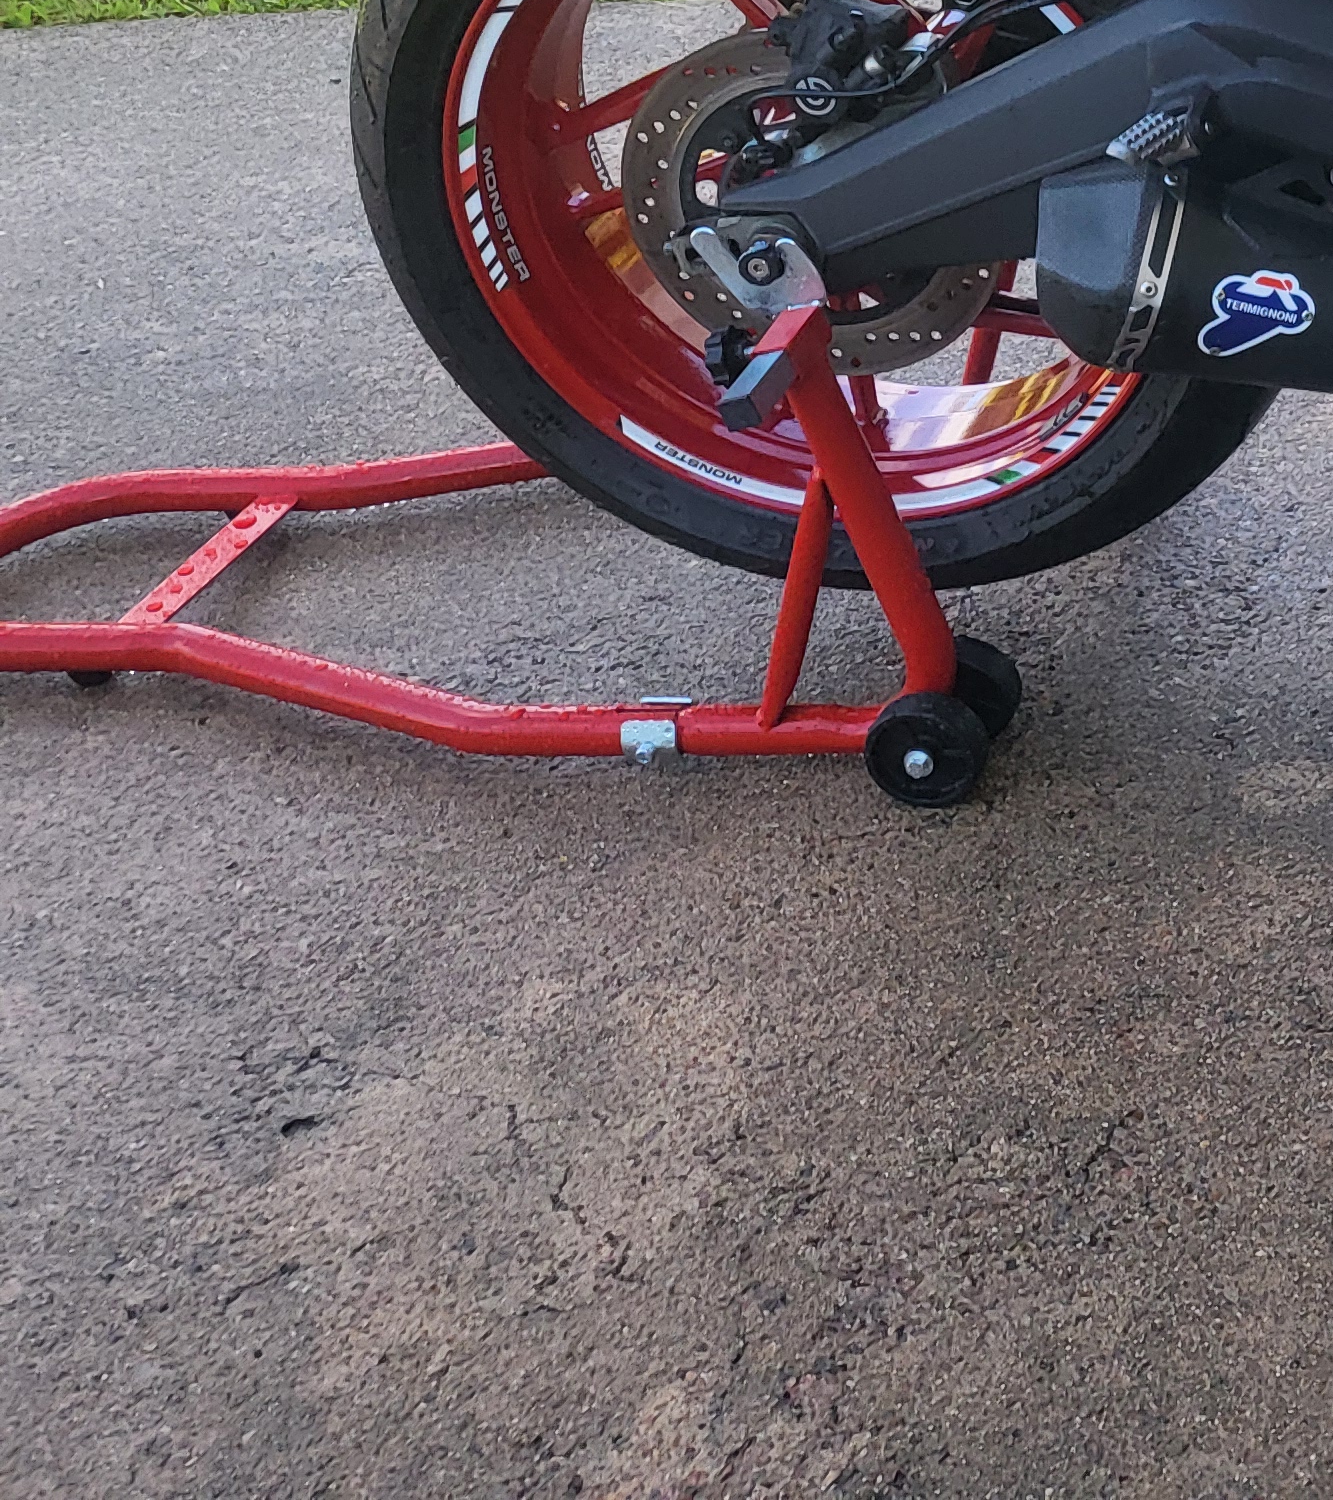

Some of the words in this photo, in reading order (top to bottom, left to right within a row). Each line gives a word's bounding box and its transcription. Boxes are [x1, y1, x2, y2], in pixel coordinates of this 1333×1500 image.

[476, 145, 532, 282] MONSTER
[1225, 298, 1299, 325] TERMIGNONI
[654, 441, 743, 486] MONSTER
